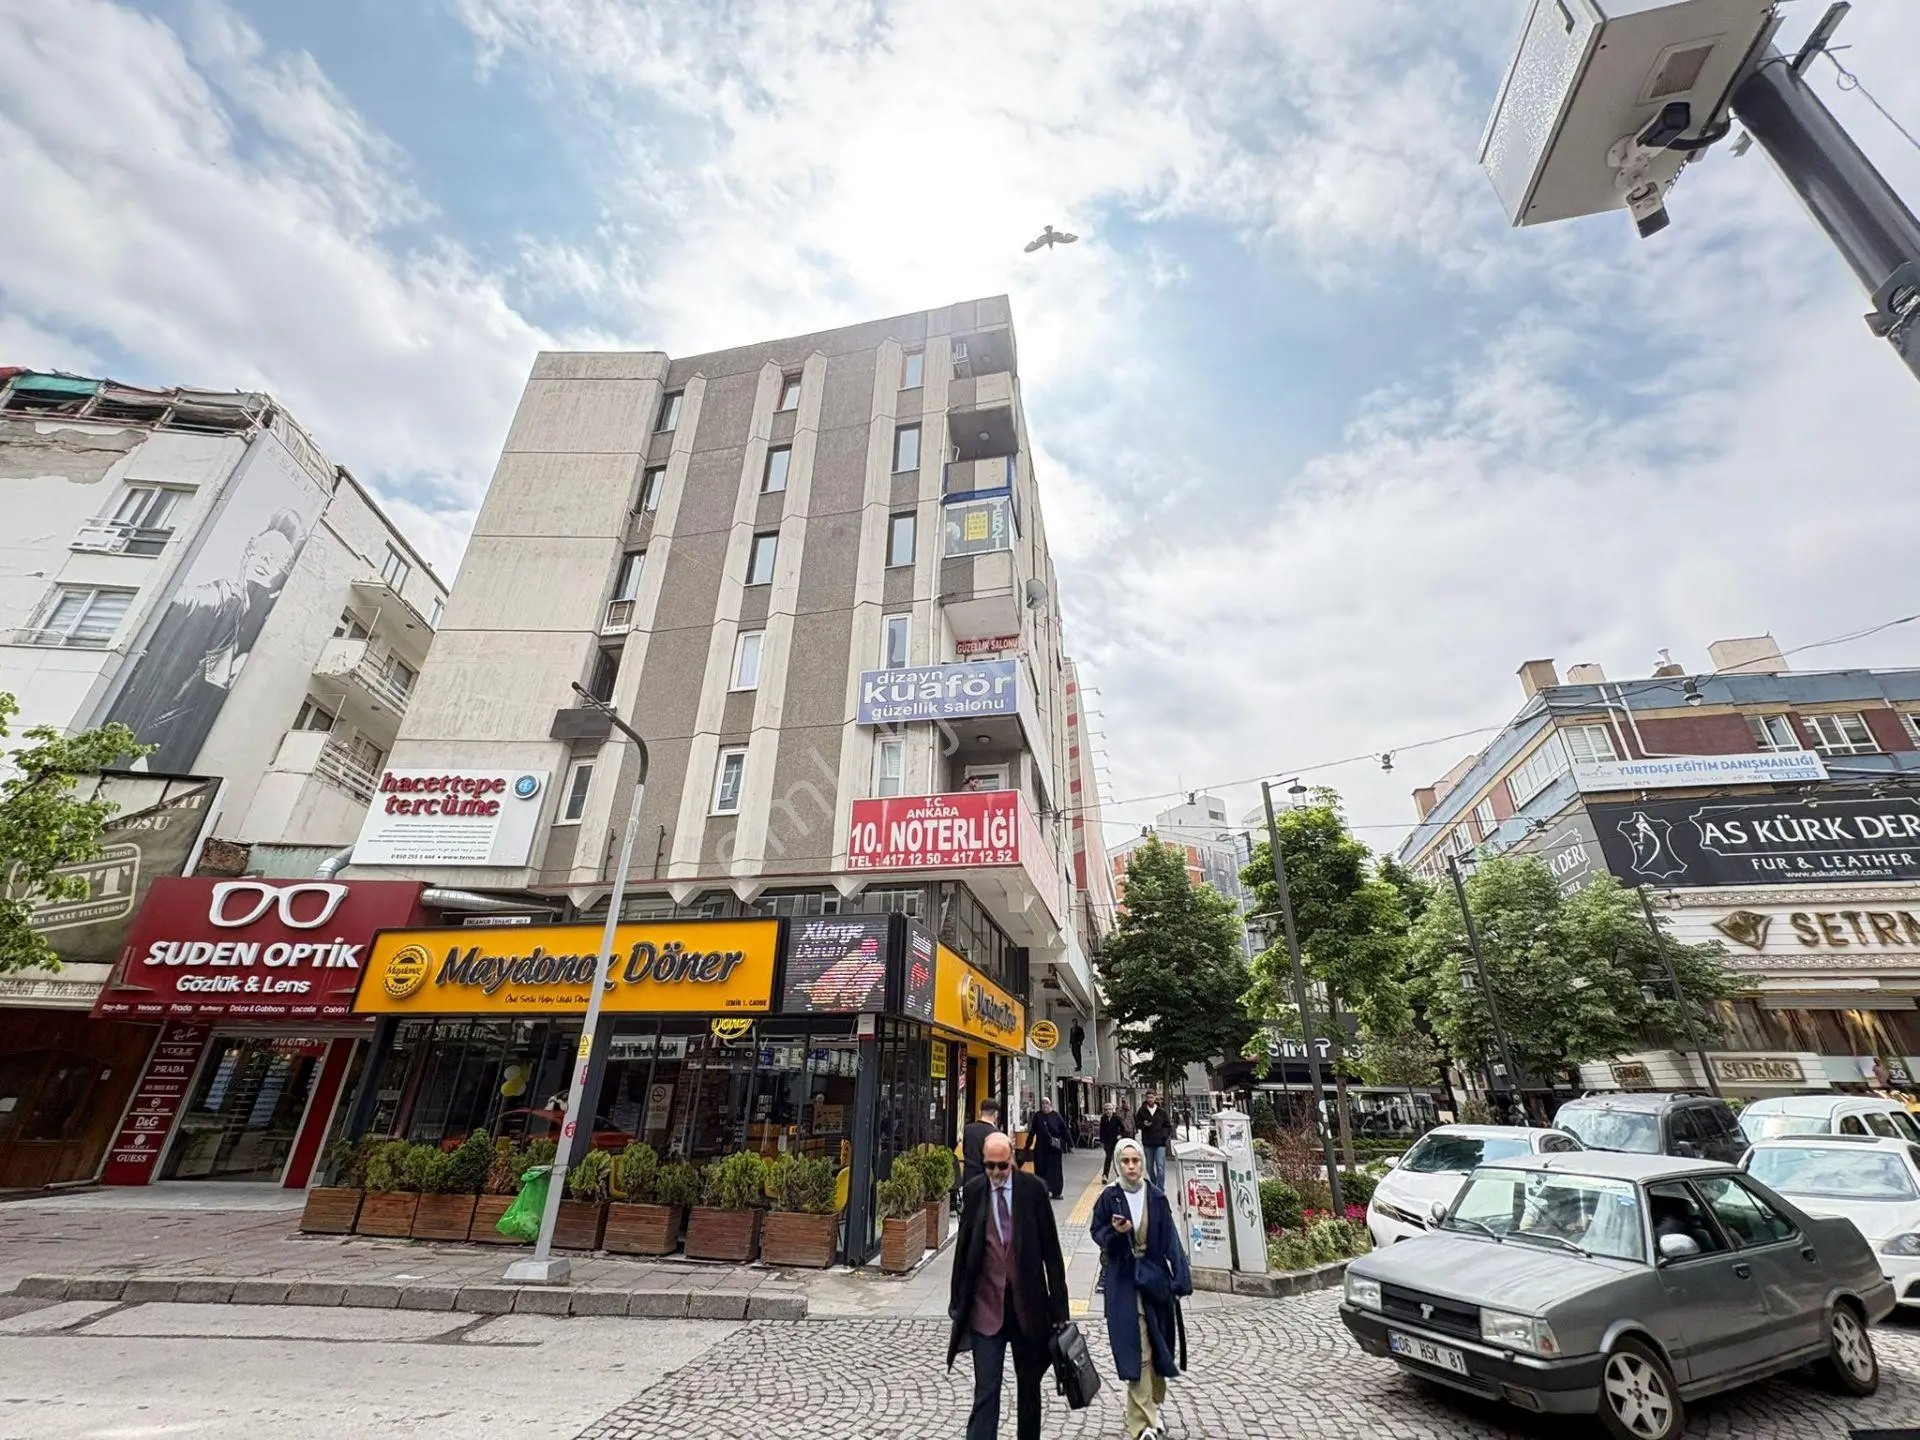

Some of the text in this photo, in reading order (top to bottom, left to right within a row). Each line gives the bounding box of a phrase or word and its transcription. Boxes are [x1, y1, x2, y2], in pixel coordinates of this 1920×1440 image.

[877, 670, 943, 688] dizayn
[871, 698, 1006, 720] güzellik salonu
[1617, 754, 1815, 777] YURTDIŞI EĞİTİM DANIŞMANLIĞI
[379, 771, 507, 798] hacettepe
[384, 794, 501, 817] tercüme
[906, 806, 960, 820] ANKARA
[924, 797, 945, 808] T.C.
[851, 808, 1015, 854] 10. NOTERLİĞİ
[1703, 813, 1920, 846] AS KÜRK DER
[850, 855, 873, 868] TEL
[883, 854, 904, 867] 417
[908, 853, 923, 866] 12
[926, 852, 941, 865] 50
[951, 851, 975, 865] 417
[978, 850, 993, 863] 12
[996, 849, 1013, 862] 52
[1751, 852, 1917, 871] FUR & LEATHER
[143, 936, 365, 969] SUDEN OPTİK
[622, 939, 745, 985] Döner
[176, 973, 311, 994] Gözlük & Lens
[153, 1065, 185, 1073] PRADA
[135, 1116, 160, 1127] D&G
[116, 1154, 149, 1163] GUESS
[1397, 1336, 1412, 1354] 06
[1448, 1351, 1464, 1371] 81
